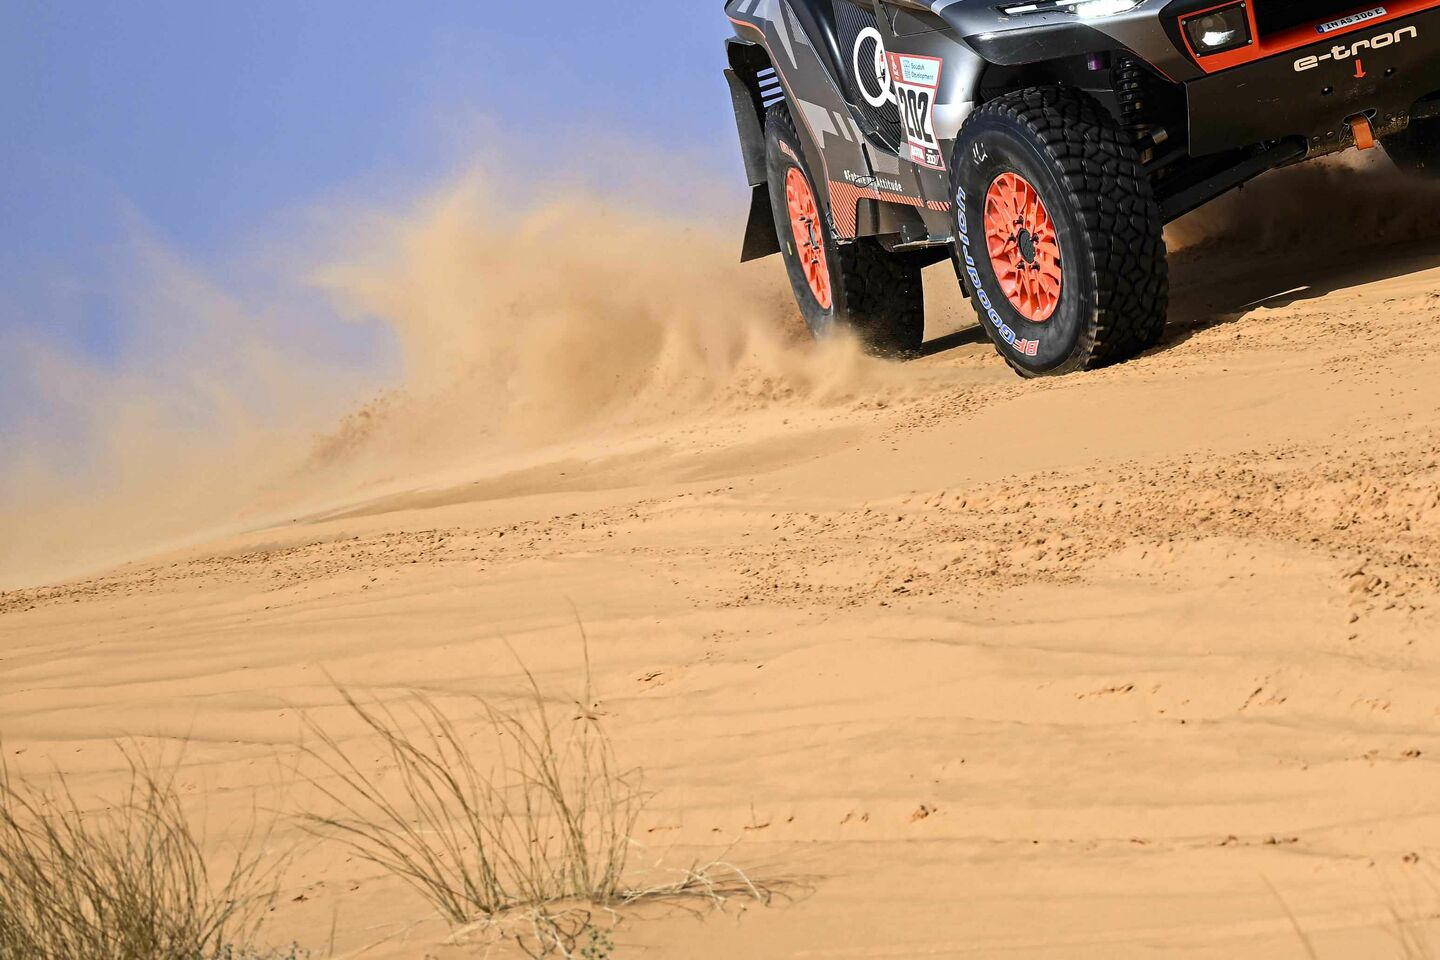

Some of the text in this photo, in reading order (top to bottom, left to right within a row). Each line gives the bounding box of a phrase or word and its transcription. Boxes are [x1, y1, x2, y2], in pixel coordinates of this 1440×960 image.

[1293, 25, 1418, 72] e-tron
[1326, 21, 1339, 30] IN
[897, 86, 934, 144] 202
[955, 185, 1040, 357] BFGoodrich
